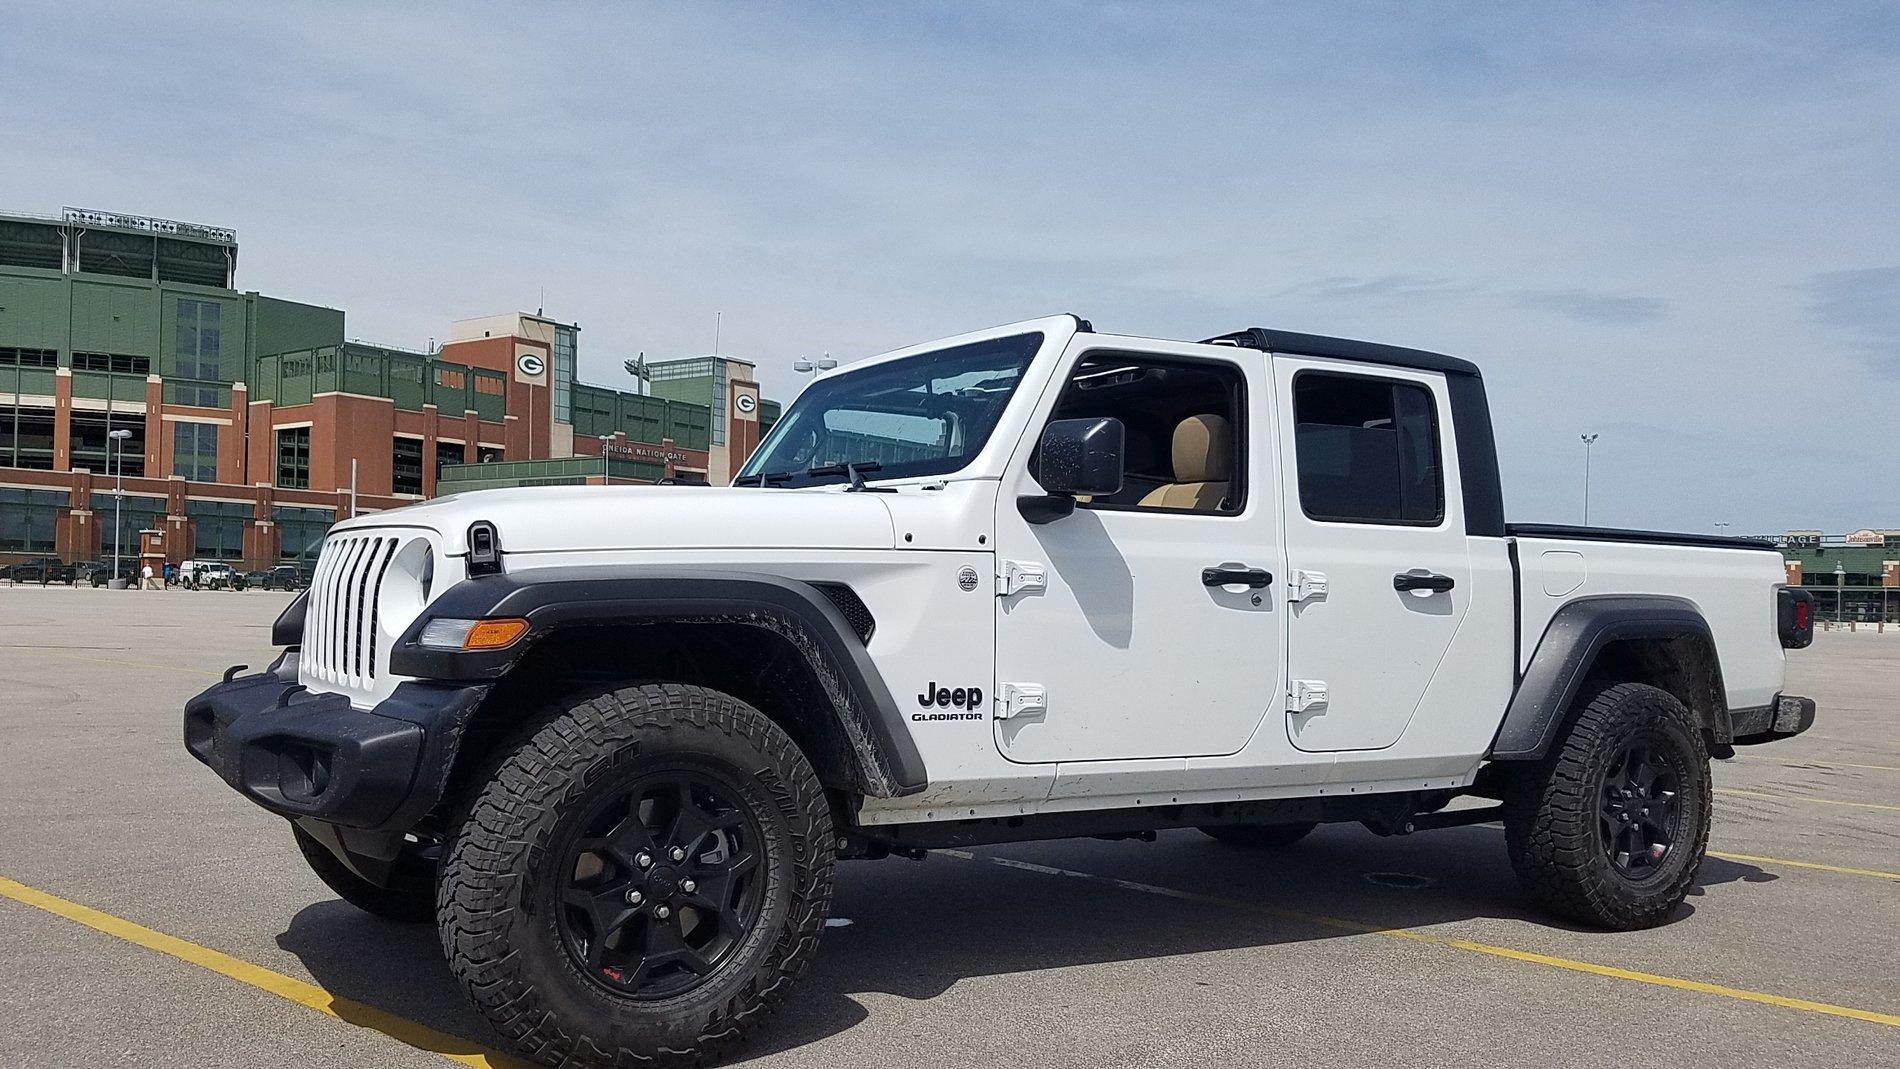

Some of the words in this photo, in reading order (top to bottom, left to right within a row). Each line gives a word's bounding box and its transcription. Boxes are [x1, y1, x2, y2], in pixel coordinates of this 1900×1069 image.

[602, 444, 633, 454] ONEIDA
[636, 447, 665, 458] NATION
[667, 452, 687, 461] GATE
[918, 682, 983, 711] Jeep
[912, 713, 983, 722] GLADIATOR
